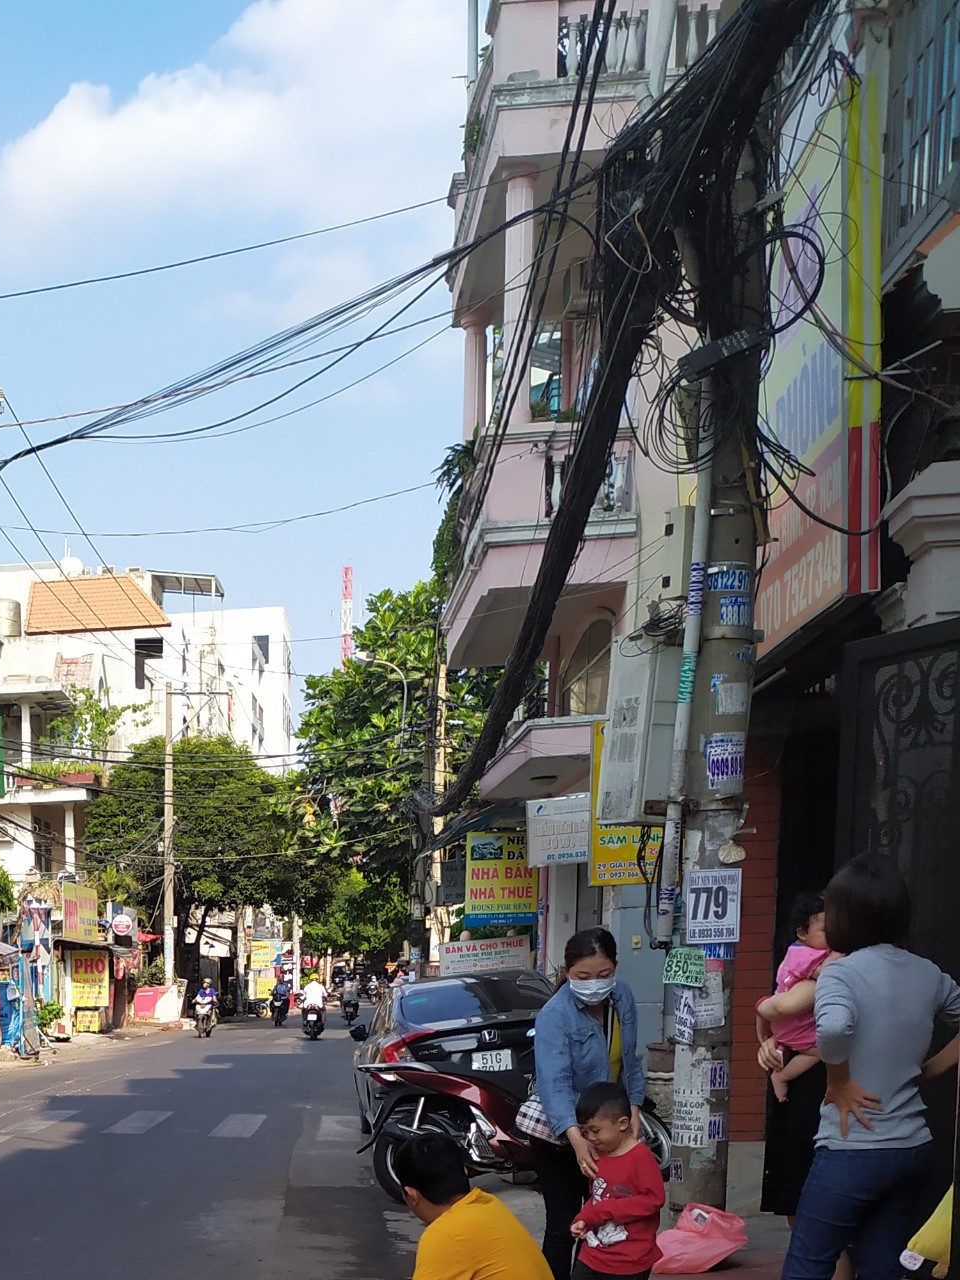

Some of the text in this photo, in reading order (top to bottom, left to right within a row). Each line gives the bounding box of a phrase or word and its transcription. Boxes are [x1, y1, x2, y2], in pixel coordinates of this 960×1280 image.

[784, 530, 841, 624] 7527349
[599, 832, 627, 846] SÂM
[471, 863, 500, 880] NHÀ
[504, 862, 533, 880] BÁN
[469, 882, 533, 900] NHÀ THUÊ
[471, 902, 532, 912] HOUSE FOR RENT
[690, 886, 729, 921] 779
[698, 928, 712, 938] 0933
[445, 938, 524, 955] BÁN VÀ CHO THUÊ
[73, 952, 106, 975] PHỞ
[664, 960, 689, 974] 850
[481, 1052, 502, 1066] 51G
